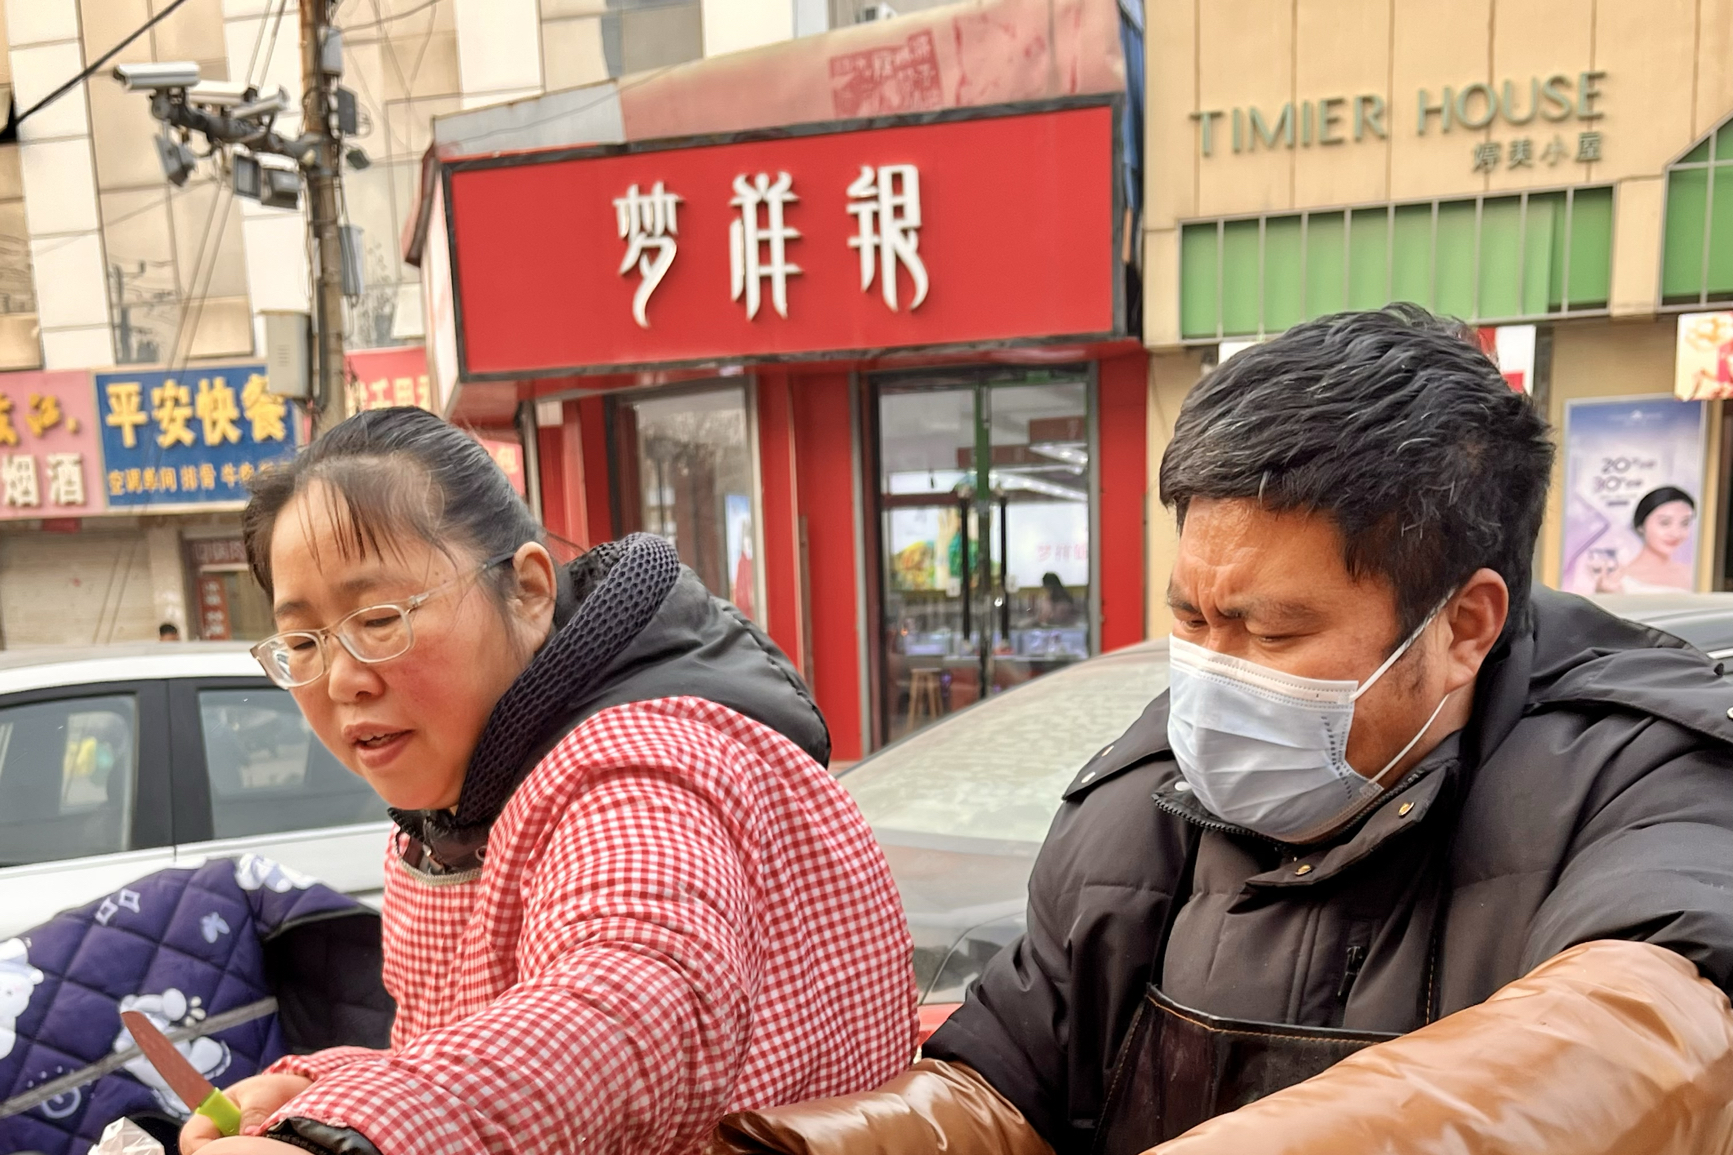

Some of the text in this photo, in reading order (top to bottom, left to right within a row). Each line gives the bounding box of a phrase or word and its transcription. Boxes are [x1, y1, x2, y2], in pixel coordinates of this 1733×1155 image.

[1189, 72, 1606, 157] TIMIER HOUSE
[612, 164, 929, 329] 梦祥银
[106, 373, 287, 448] 平安快餐
[2, 453, 86, 507] 烟酒
